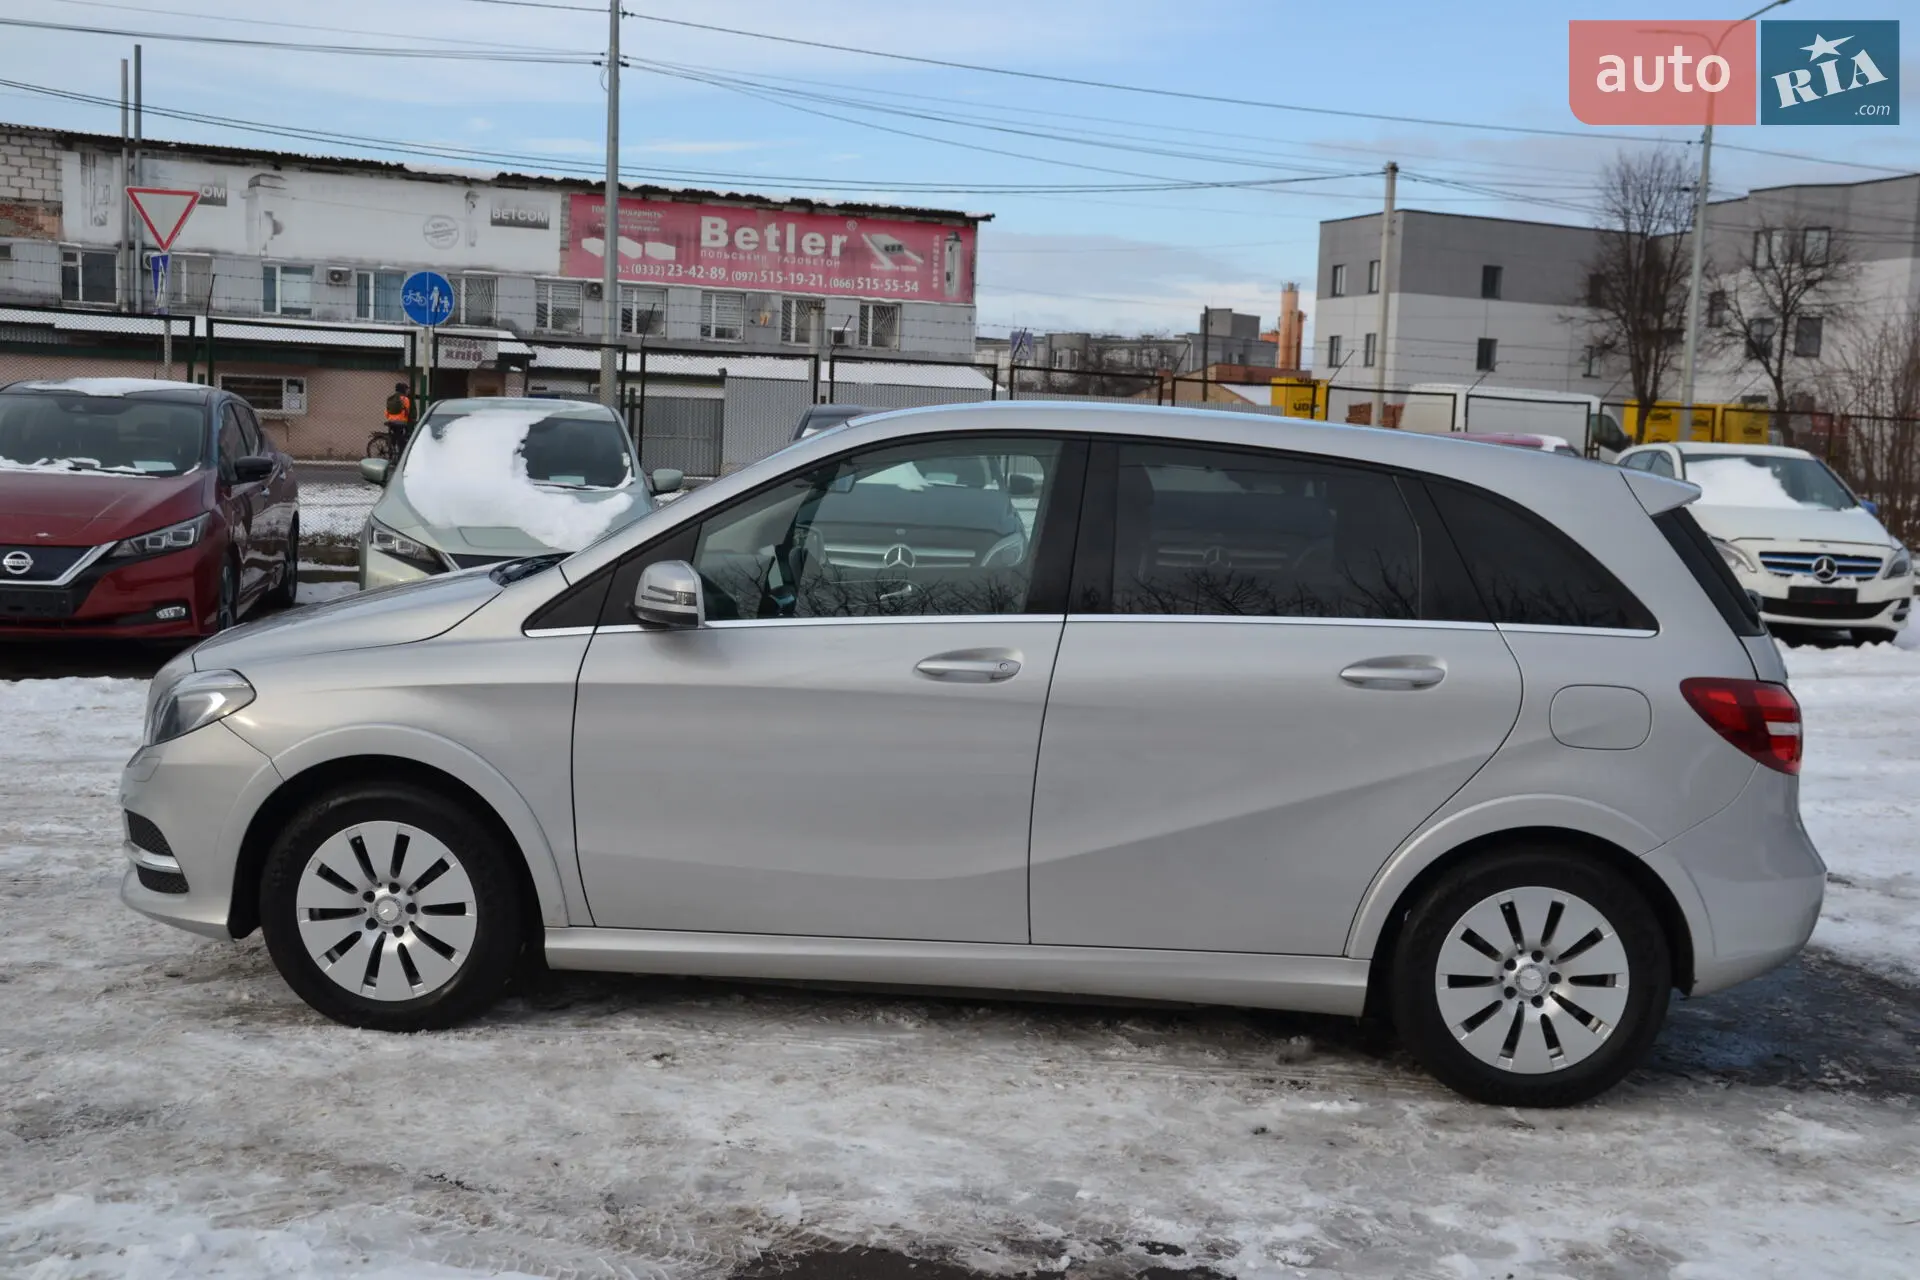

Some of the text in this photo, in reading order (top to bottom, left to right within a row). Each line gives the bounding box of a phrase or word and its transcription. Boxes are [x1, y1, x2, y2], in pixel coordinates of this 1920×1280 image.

[631, 263, 665, 277] (0332)
[731, 271, 758, 283] (097)
[760, 270, 827, 288] 515-19-21,
[829, 277, 855, 290] (066)
[857, 276, 919, 292] 515-55-54
